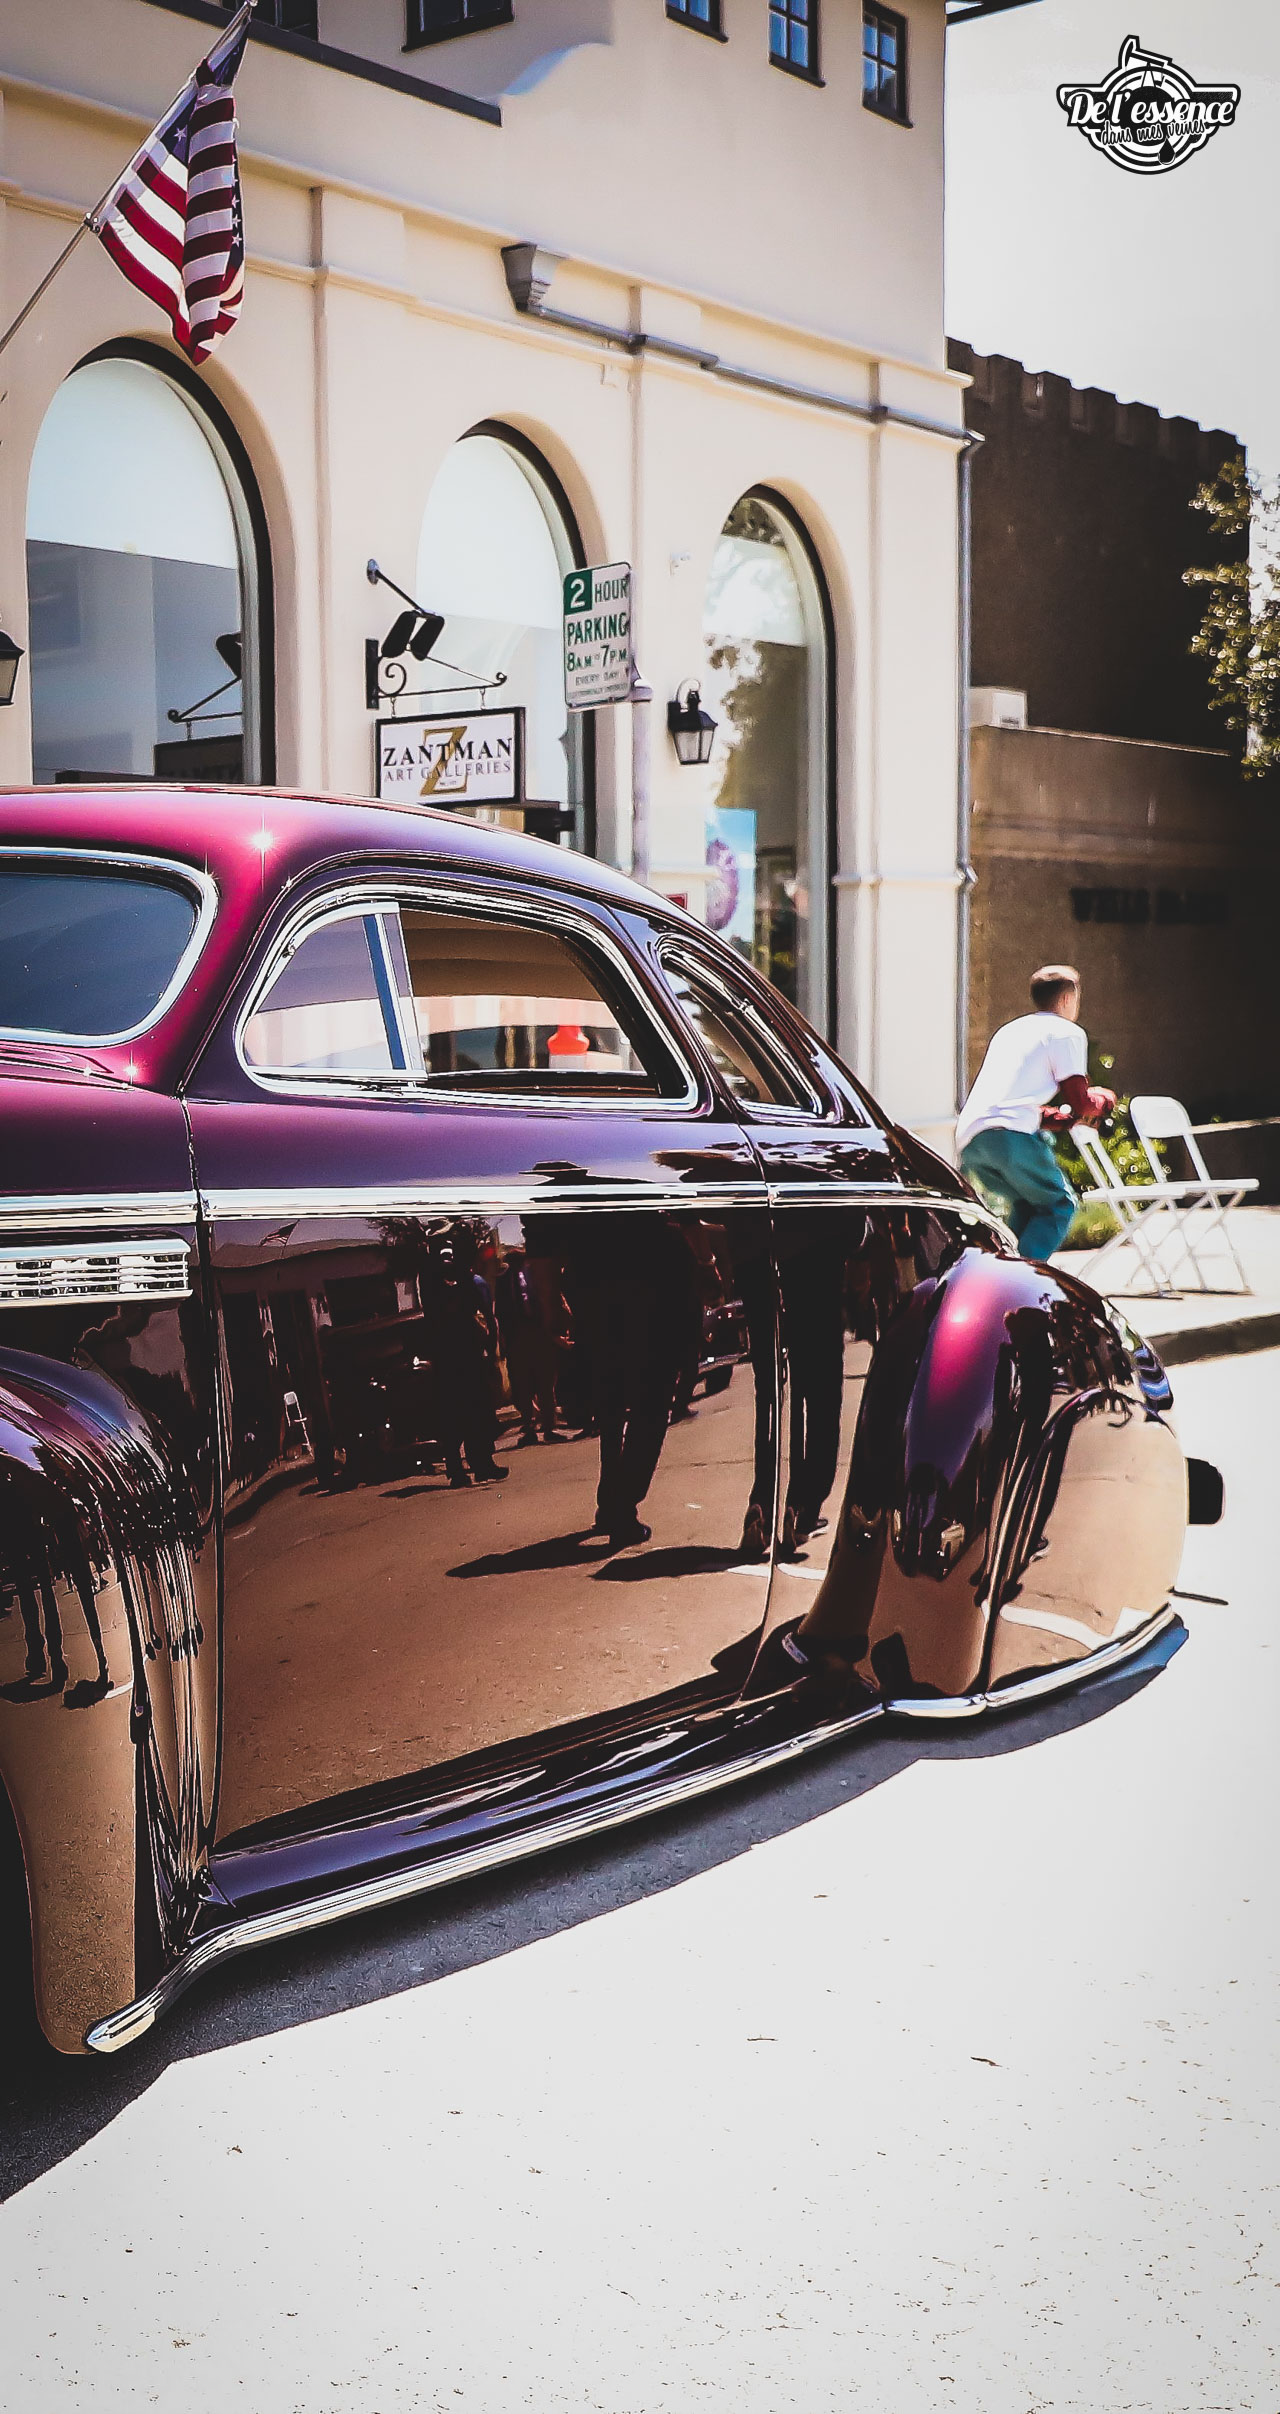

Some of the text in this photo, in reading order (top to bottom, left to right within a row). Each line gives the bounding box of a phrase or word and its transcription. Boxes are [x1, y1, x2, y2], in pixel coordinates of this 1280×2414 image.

[570, 578, 627, 608] 2 HOUR
[568, 612, 628, 646] PARKING
[383, 738, 512, 767] ZANTMAN
[384, 760, 511, 782] ART GALLERIES
